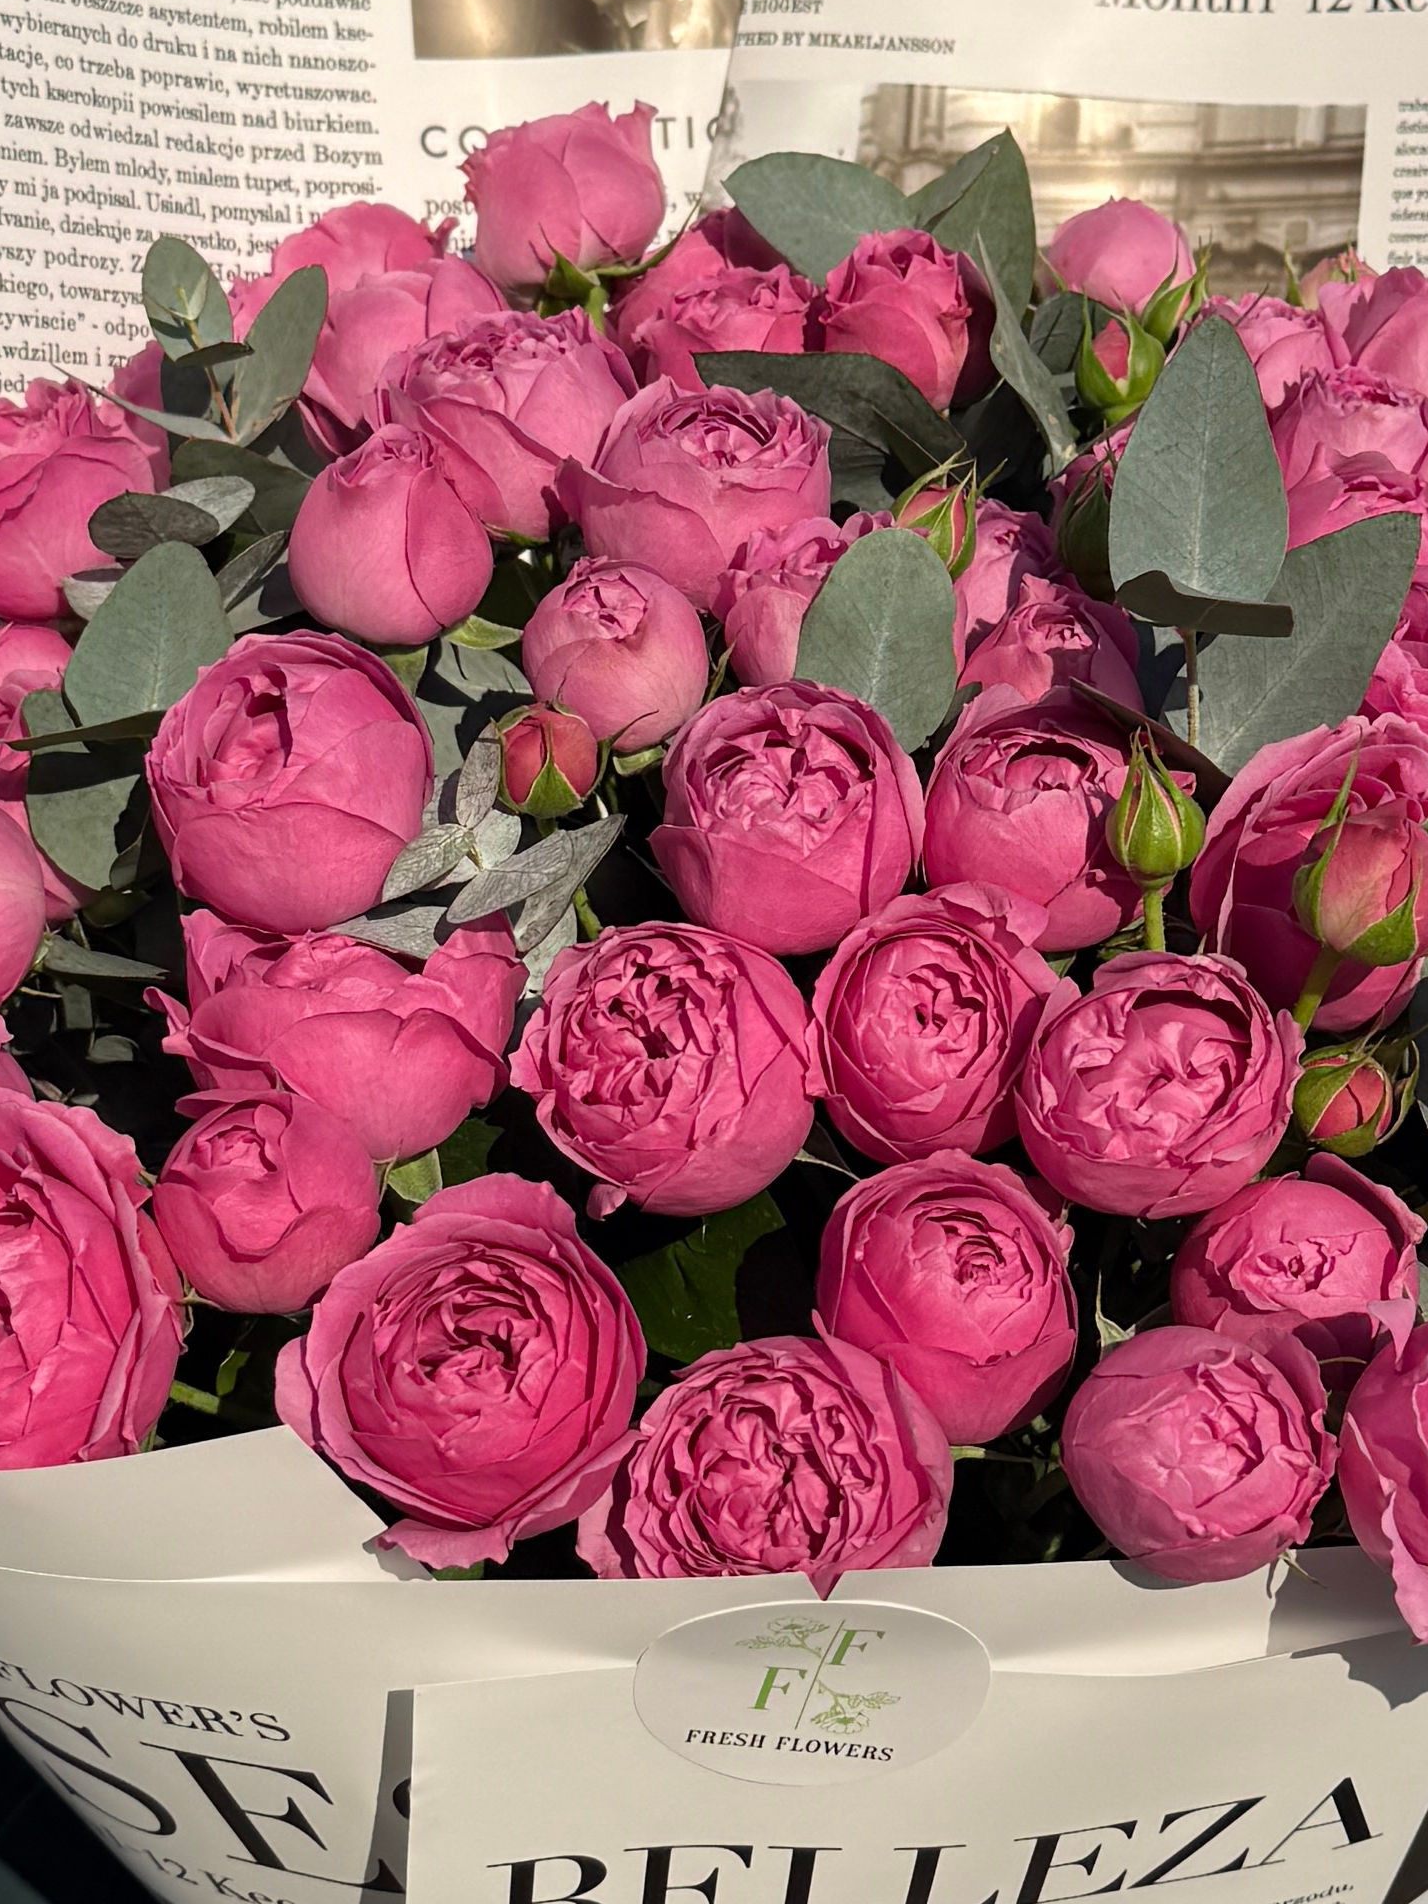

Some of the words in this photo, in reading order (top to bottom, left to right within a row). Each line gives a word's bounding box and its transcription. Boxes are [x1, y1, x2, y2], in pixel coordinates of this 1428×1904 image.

[148, 6, 253, 38] asystentem,
[258, 16, 329, 40] robilem
[333, 20, 373, 42] kse-
[782, 32, 806, 47] BY
[116, 26, 139, 49] do
[142, 31, 198, 58] druku
[202, 39, 210, 60] i
[214, 46, 238, 63] na
[242, 45, 283, 68] nich
[288, 54, 376, 73] nanoszo-
[54, 54, 74, 71] co
[78, 55, 136, 81] trzeba
[140, 68, 230, 98] poprawic,
[235, 81, 377, 104] wyretuszowac.
[0, 75, 40, 100] tych
[44, 79, 135, 116] kserokopii
[139, 99, 237, 126] powiesilem
[241, 109, 278, 130] nad
[282, 110, 379, 135] biurkiem.
[4, 113, 65, 135] zawsze
[69, 118, 160, 149] odwiedzal
[165, 132, 245, 162] redakcje
[250, 142, 306, 164] przed
[313, 143, 383, 169] Bozym
[53, 147, 111, 174] Bylem
[114, 157, 172, 186] mlody,
[175, 165, 241, 189] mialem
[244, 172, 301, 197] tupet,
[304, 177, 383, 199] poprosi-
[13, 180, 37, 198] mi
[40, 184, 60, 203] ja
[63, 184, 141, 211] podpisal.
[145, 191, 206, 221] Usiadl,
[210, 203, 291, 227] pomyslal
[296, 204, 303, 224] i
[825, 1628, 886, 1667] F
[747, 1665, 808, 1711] F
[684, 1728, 767, 1750] FRESH
[775, 1735, 895, 1763] FLOWERS
